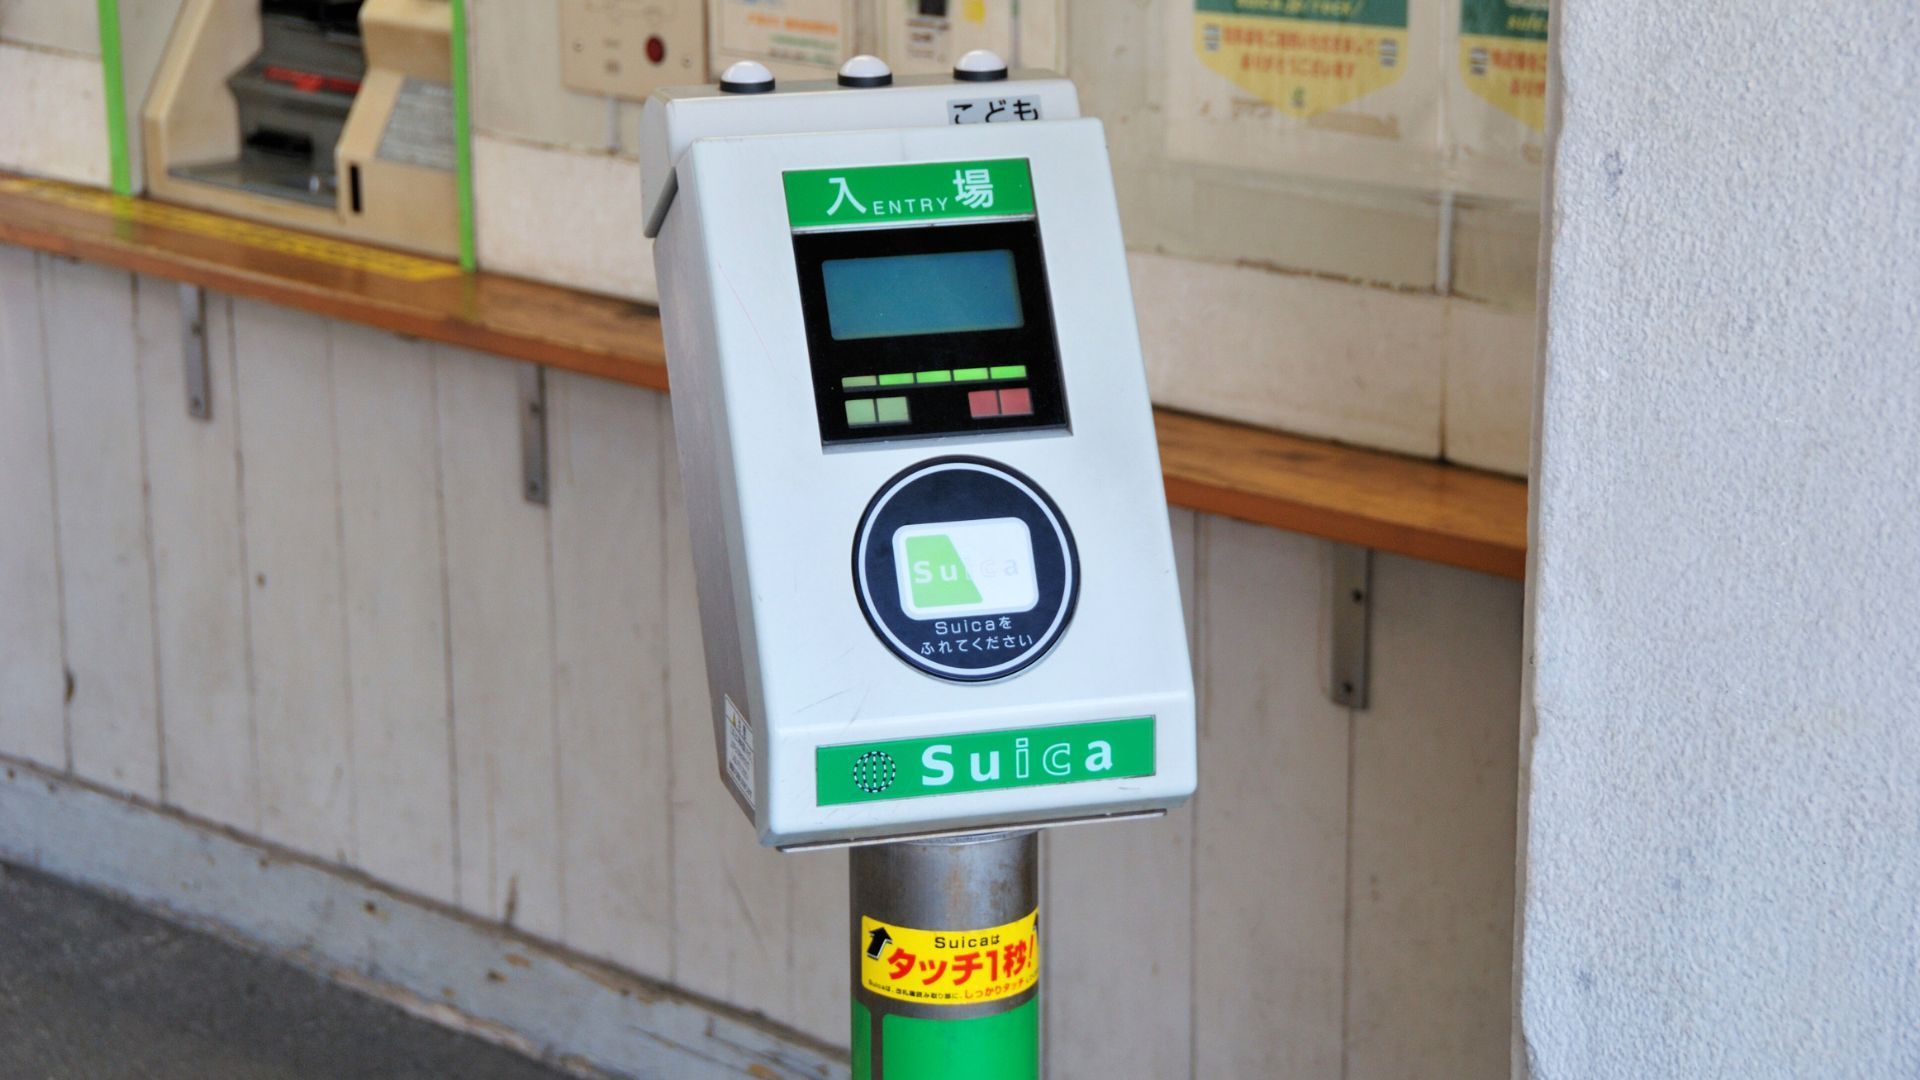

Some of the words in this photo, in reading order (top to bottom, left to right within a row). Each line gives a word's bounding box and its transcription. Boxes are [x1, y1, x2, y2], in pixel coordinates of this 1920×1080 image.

[953, 99, 1039, 124] こども
[872, 197, 948, 215] ENTRY
[935, 616, 1013, 635] Suicaを
[921, 634, 1033, 655] ふれてください
[921, 737, 1113, 786] Suica
[934, 934, 1000, 949] Suicaは
